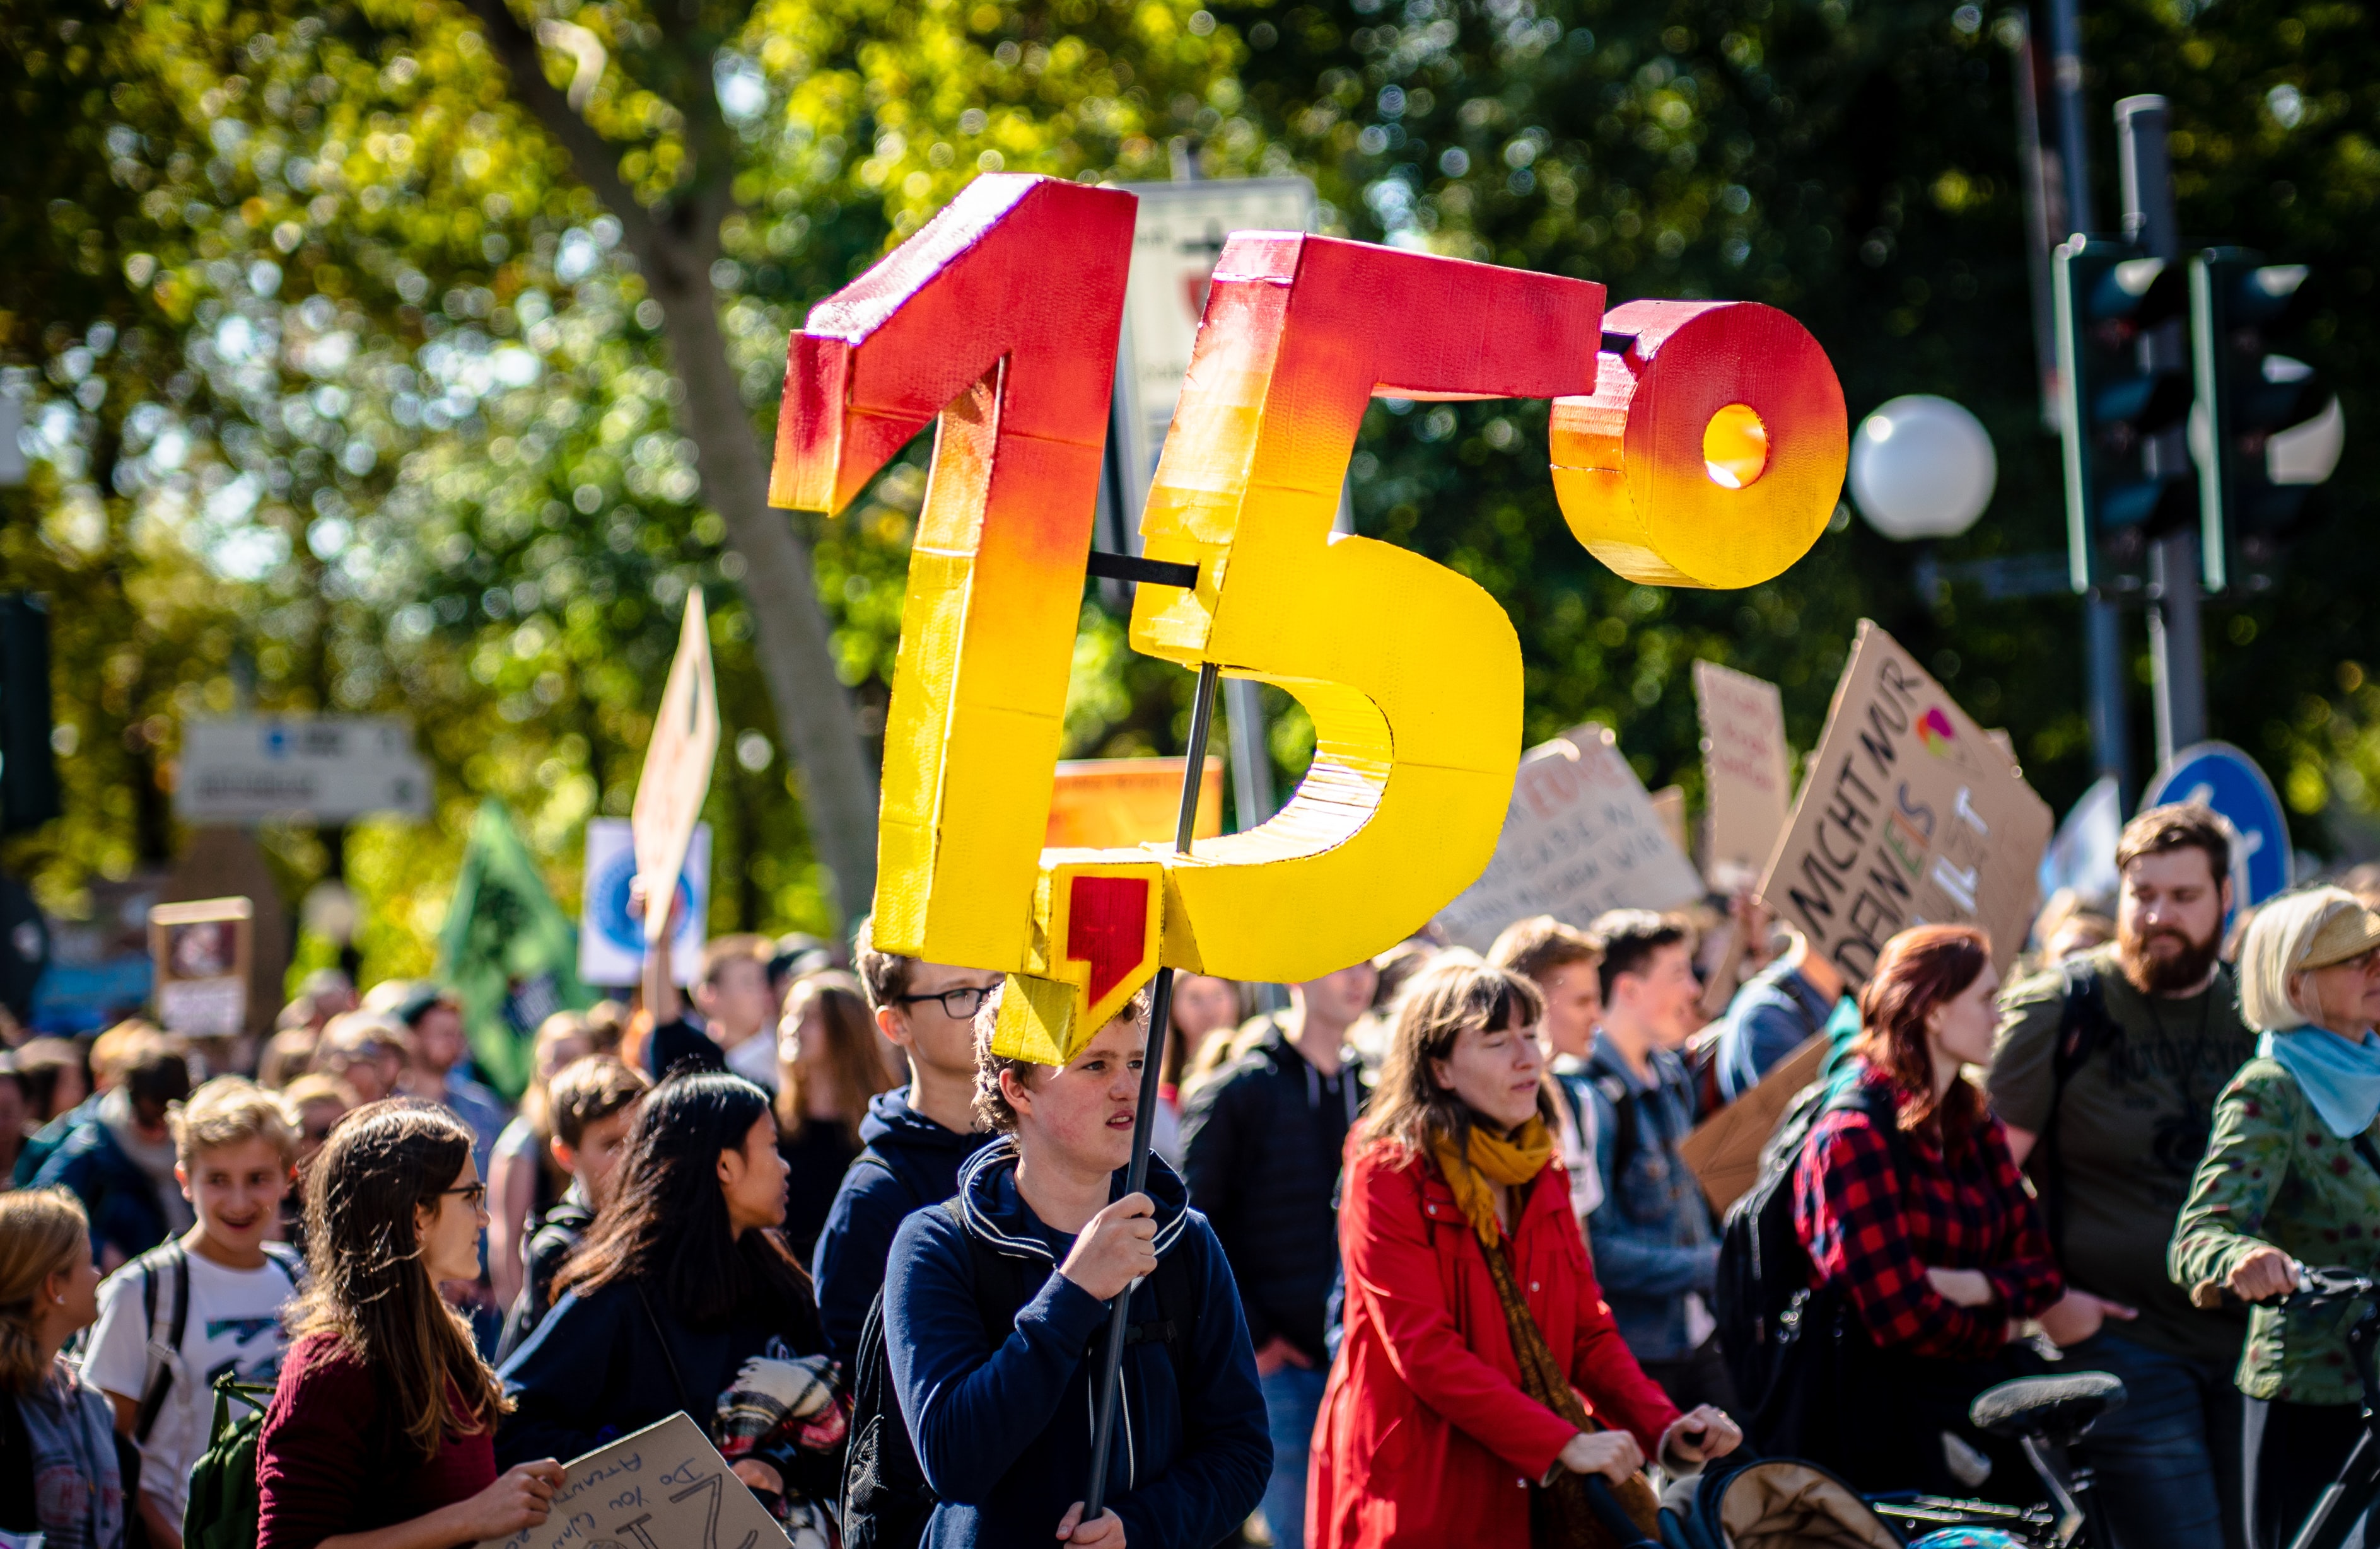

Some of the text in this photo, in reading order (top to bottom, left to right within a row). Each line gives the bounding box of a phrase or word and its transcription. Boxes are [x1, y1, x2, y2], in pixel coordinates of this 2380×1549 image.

[1860, 656, 1926, 779] NUR
[1882, 780, 1937, 879] EIS
[548, 1452, 642, 1509] ATLANTI
